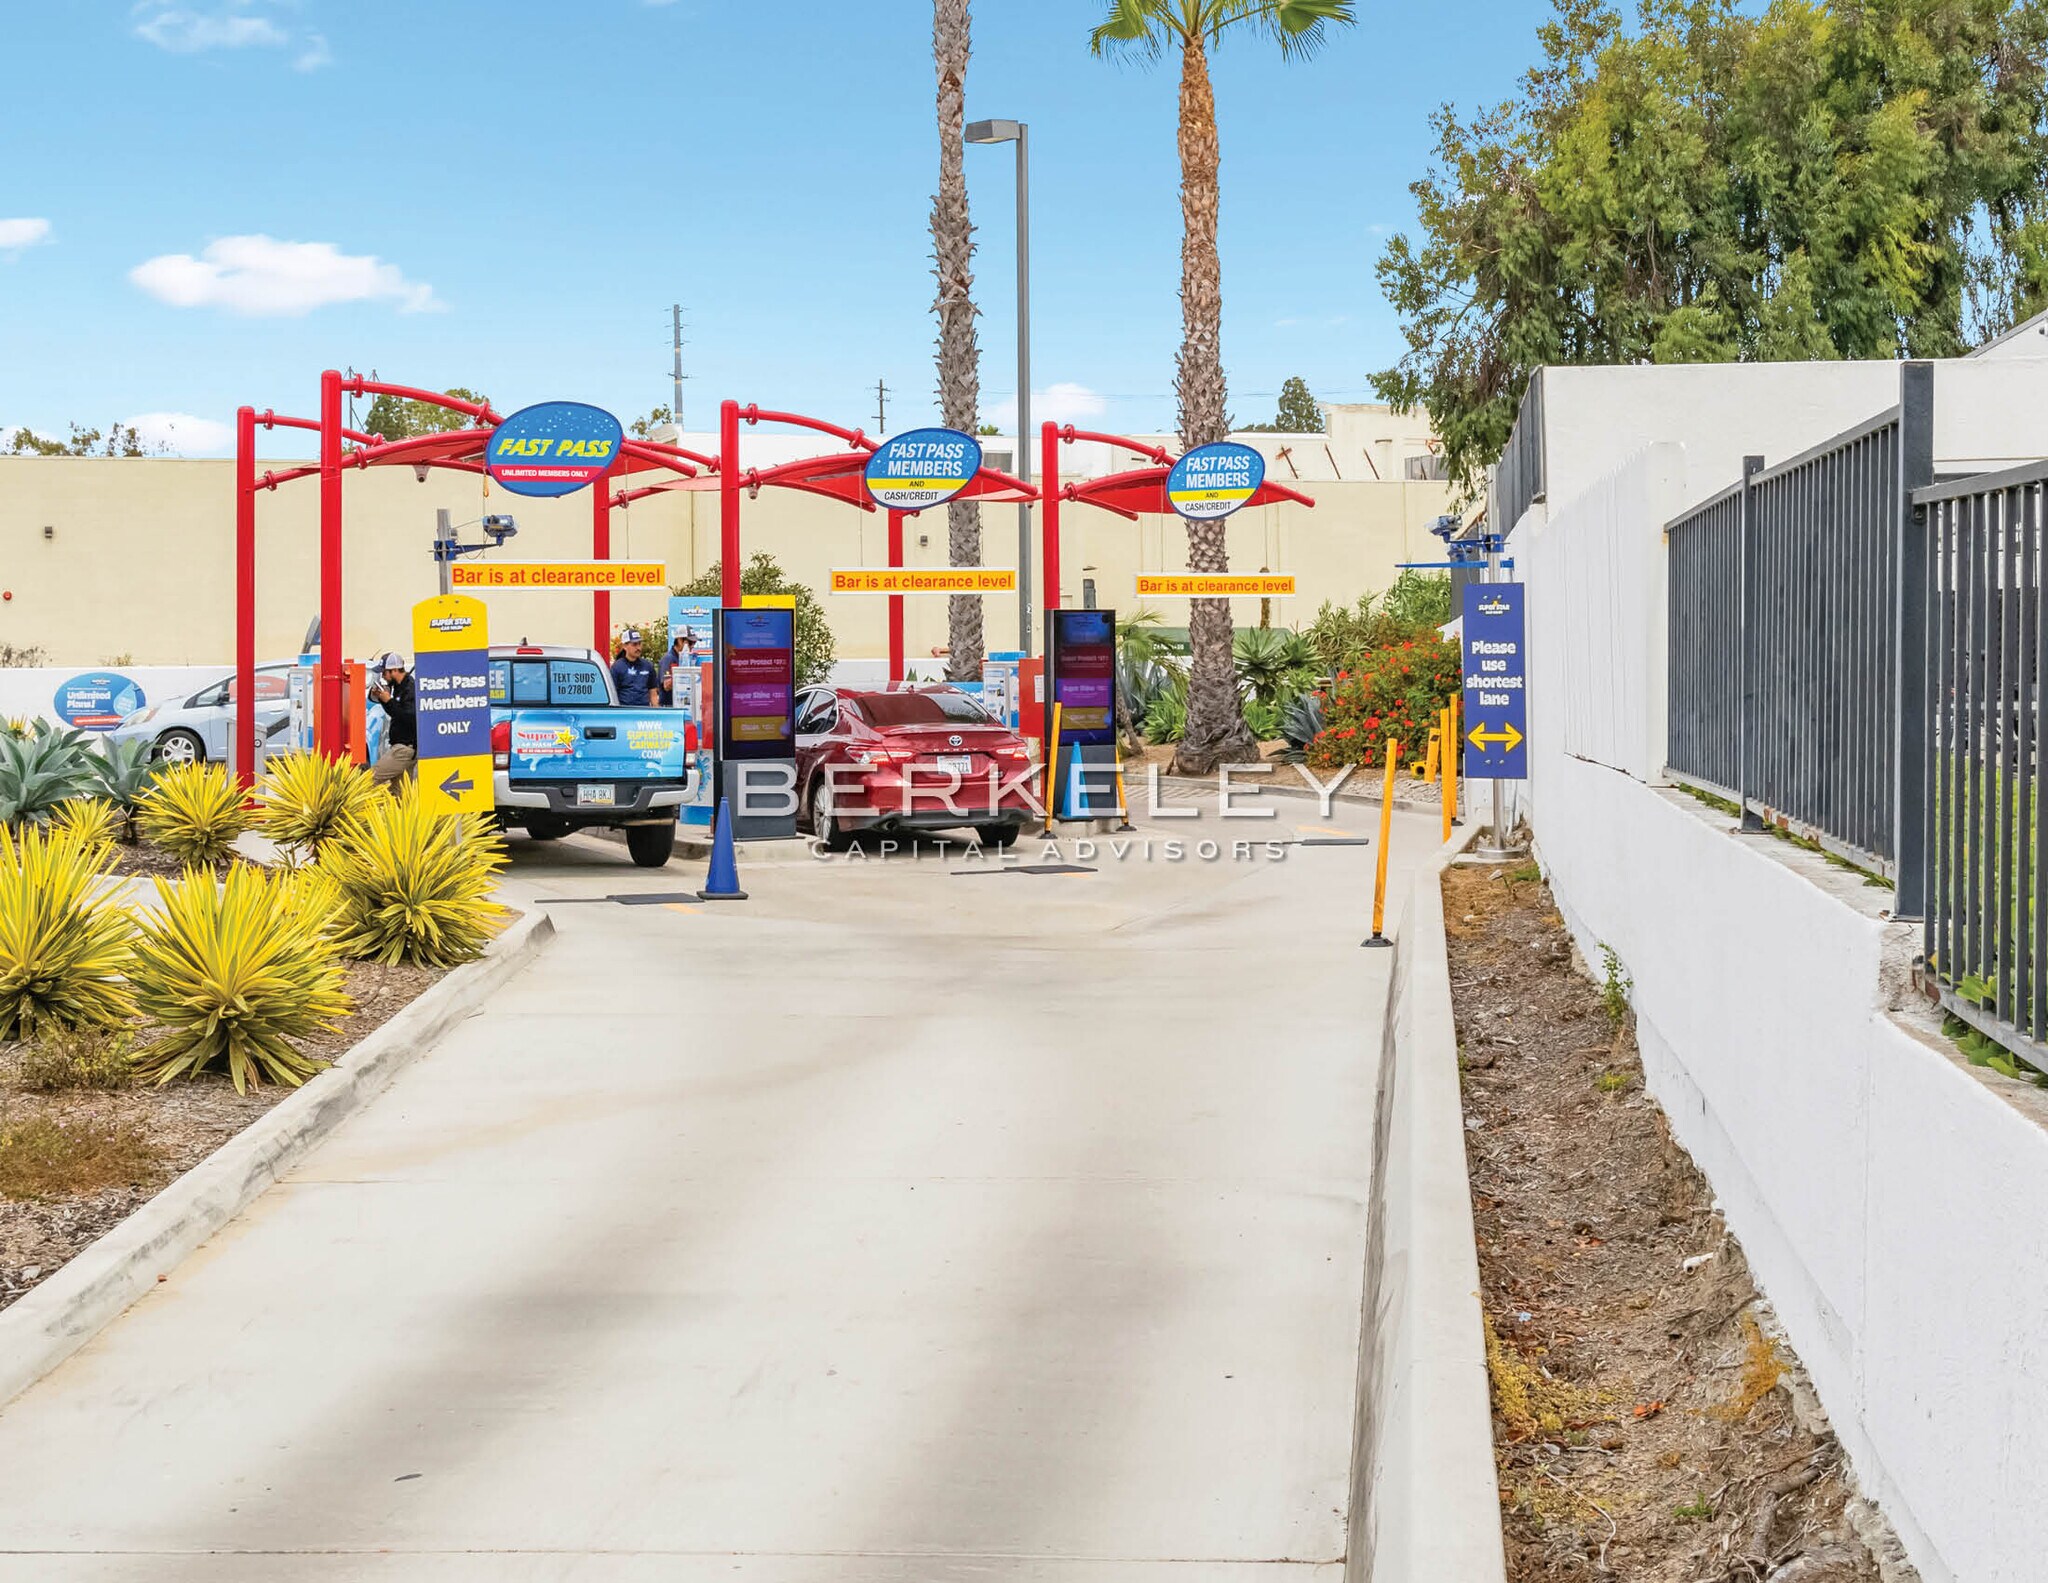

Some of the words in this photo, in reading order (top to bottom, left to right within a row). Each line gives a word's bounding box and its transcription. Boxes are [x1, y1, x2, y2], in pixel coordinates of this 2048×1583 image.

[496, 439, 554, 456] FAST
[556, 439, 614, 458] PASS
[889, 443, 924, 458] FAST
[926, 443, 965, 459] PASS
[887, 460, 963, 476] MEMBERS
[1186, 457, 1216, 471] FAST
[1217, 455, 1251, 470] PASS
[501, 469, 537, 477] UNLIMITED
[538, 469, 570, 477] MEMBERS
[570, 470, 589, 478] ONLY
[1186, 472, 1250, 488] MEMBERS
[884, 491, 939, 501] CASH/CREDIT
[1185, 501, 1231, 512] CASH/CREDIT
[452, 568, 483, 583] Bar
[489, 568, 504, 583] is
[509, 568, 526, 583] at
[531, 568, 615, 583] clearance
[621, 567, 661, 583] level
[835, 575, 861, 588] Bar
[866, 575, 879, 588] is
[884, 575, 898, 588] at
[902, 574, 974, 588] clearance
[978, 574, 1012, 587] level
[1140, 580, 1163, 592] Bar
[1167, 580, 1178, 591] is
[1181, 580, 1194, 592] at
[1197, 580, 1259, 591] clearance
[1262, 579, 1292, 591] level
[430, 618, 453, 628] SUPER
[454, 617, 472, 627] STAR
[1471, 641, 1517, 655] Please
[1481, 660, 1507, 672] use
[419, 677, 450, 692] Fast
[452, 675, 487, 690] Pass
[553, 672, 570, 683] TEXT
[1466, 675, 1523, 689] shortest
[67, 691, 112, 700] Unlimited
[558, 685, 567, 695] to
[567, 685, 592, 695] 27800
[419, 694, 488, 712] Members
[1479, 691, 1510, 706] lane
[437, 720, 472, 735] ONLY
[627, 730, 674, 740] SUPERSTAR
[629, 740, 672, 750] CARWASH
